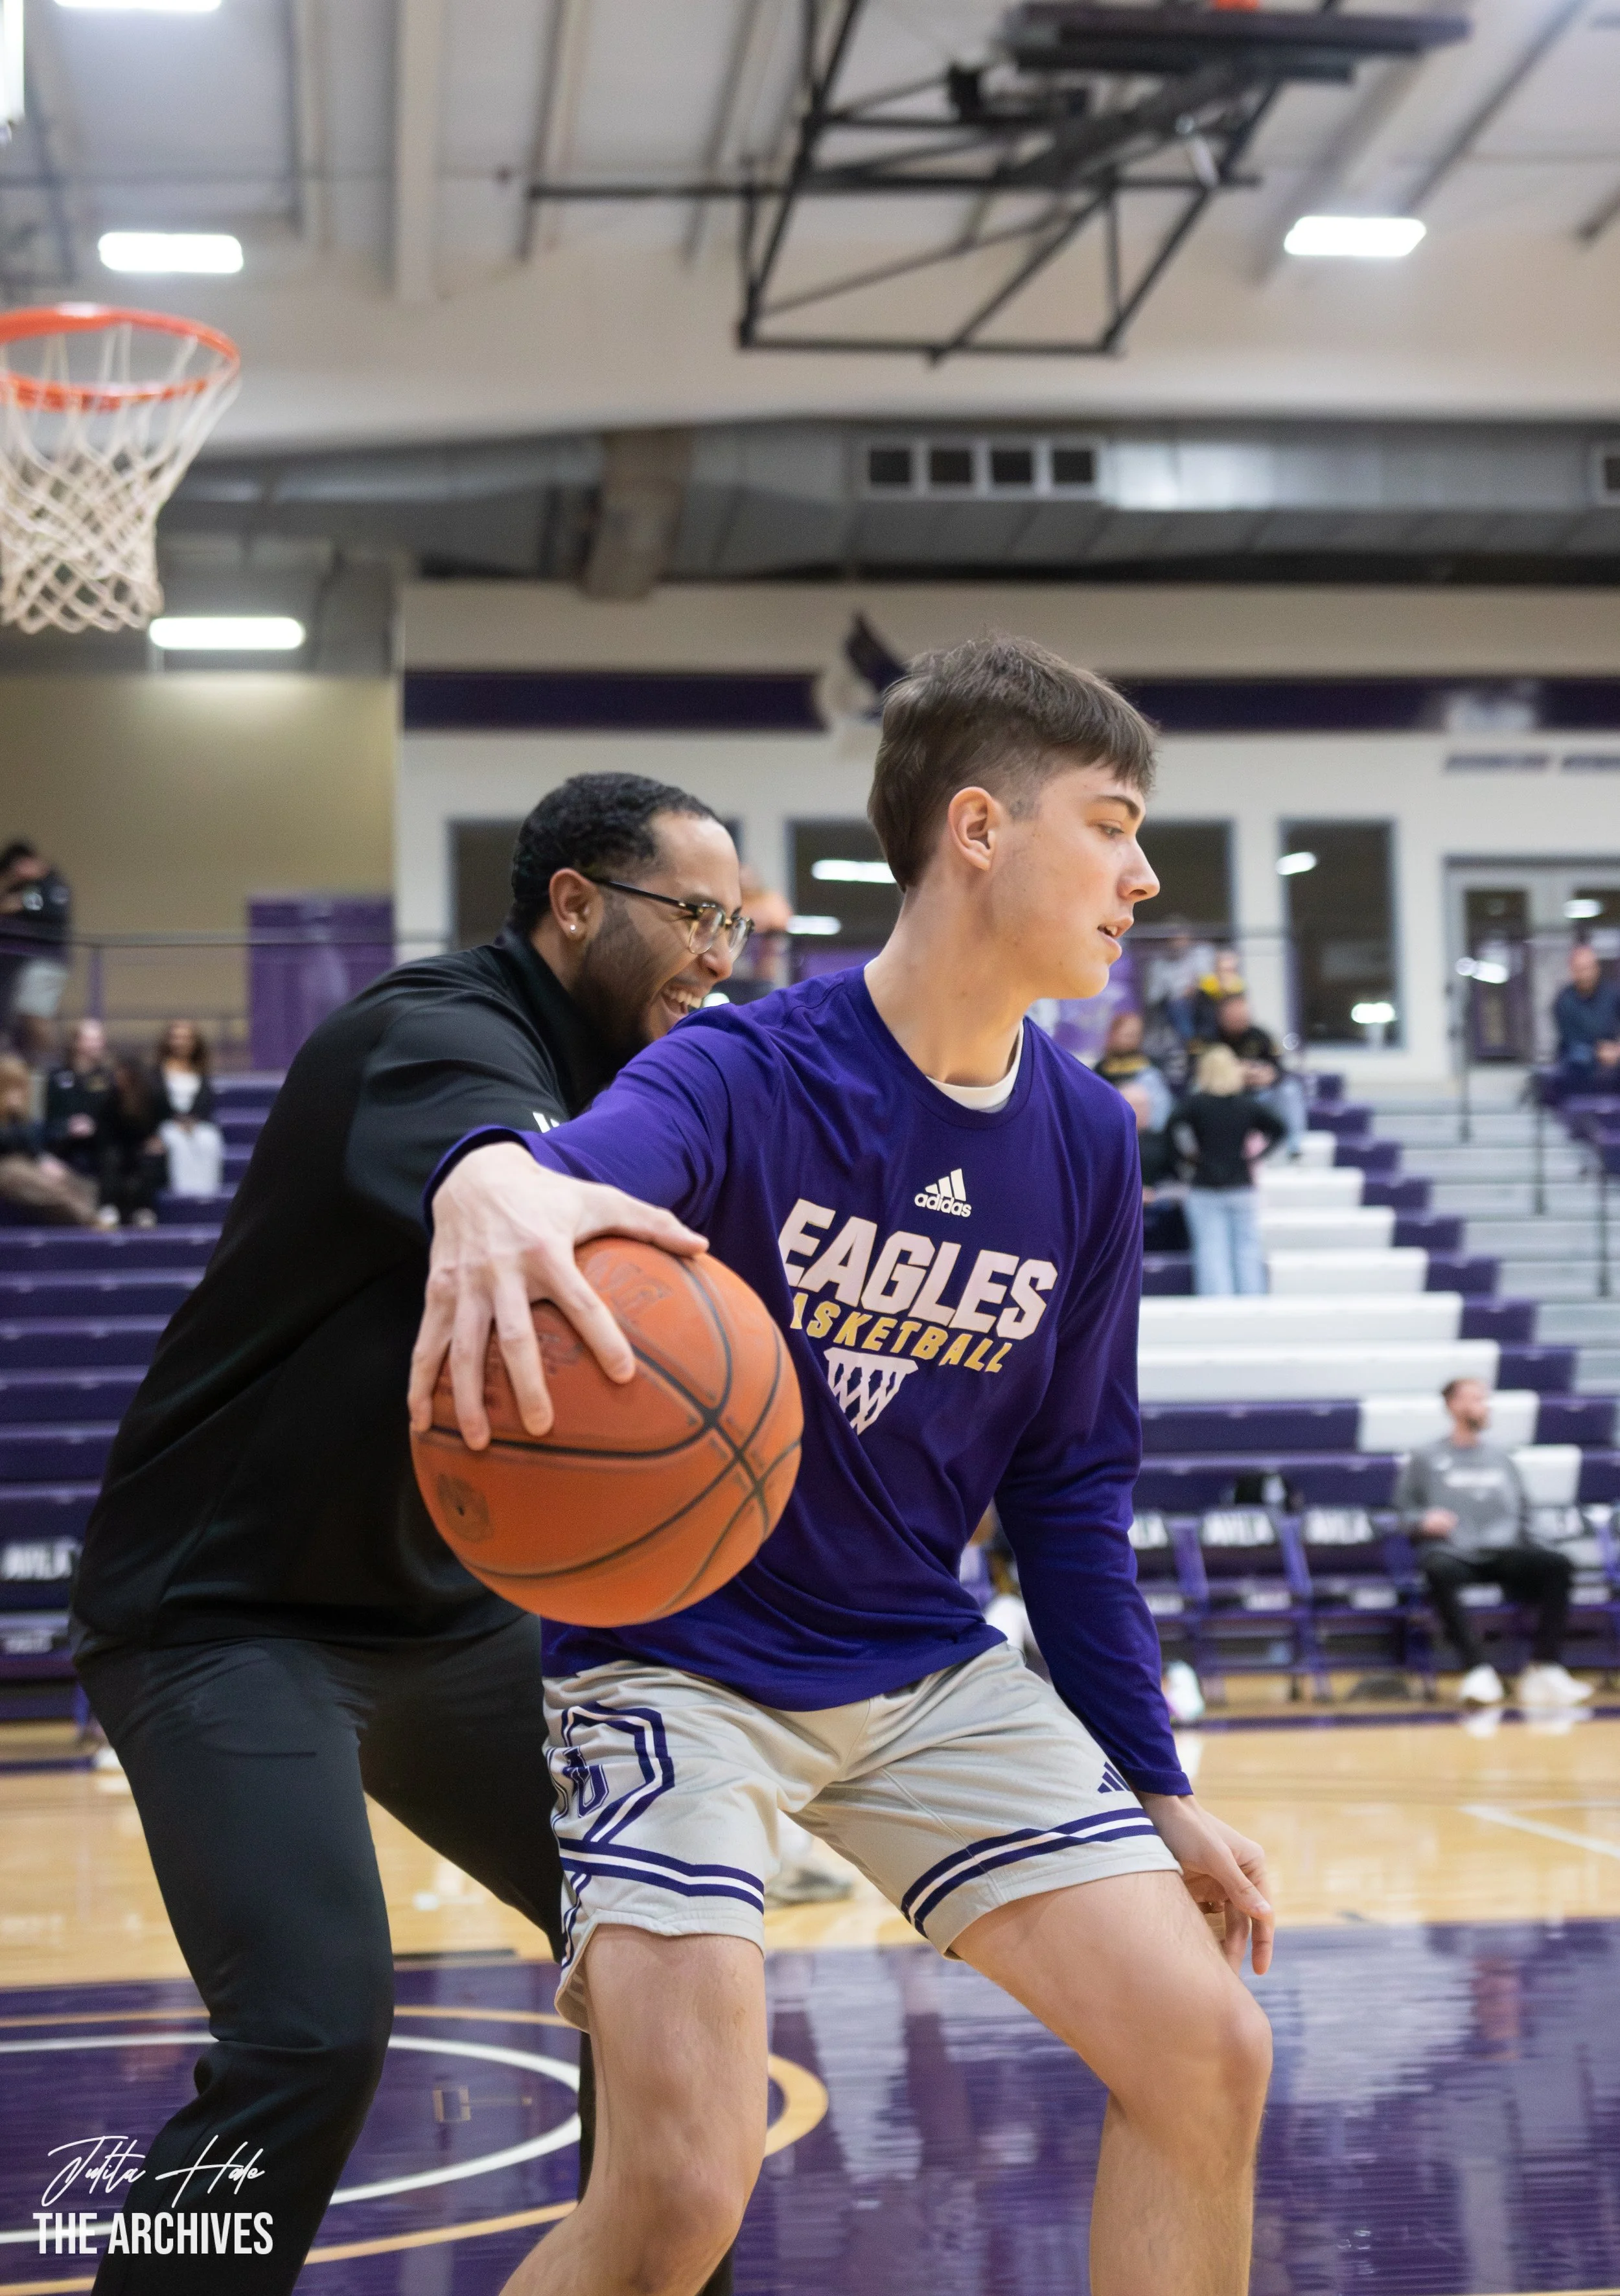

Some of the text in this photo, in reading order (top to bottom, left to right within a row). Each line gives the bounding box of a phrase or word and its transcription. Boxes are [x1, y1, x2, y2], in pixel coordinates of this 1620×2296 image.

[914, 1192, 972, 1217] adidas
[778, 1198, 1058, 1340] EAGLES
[790, 1292, 1012, 1373] ASKETBALL
